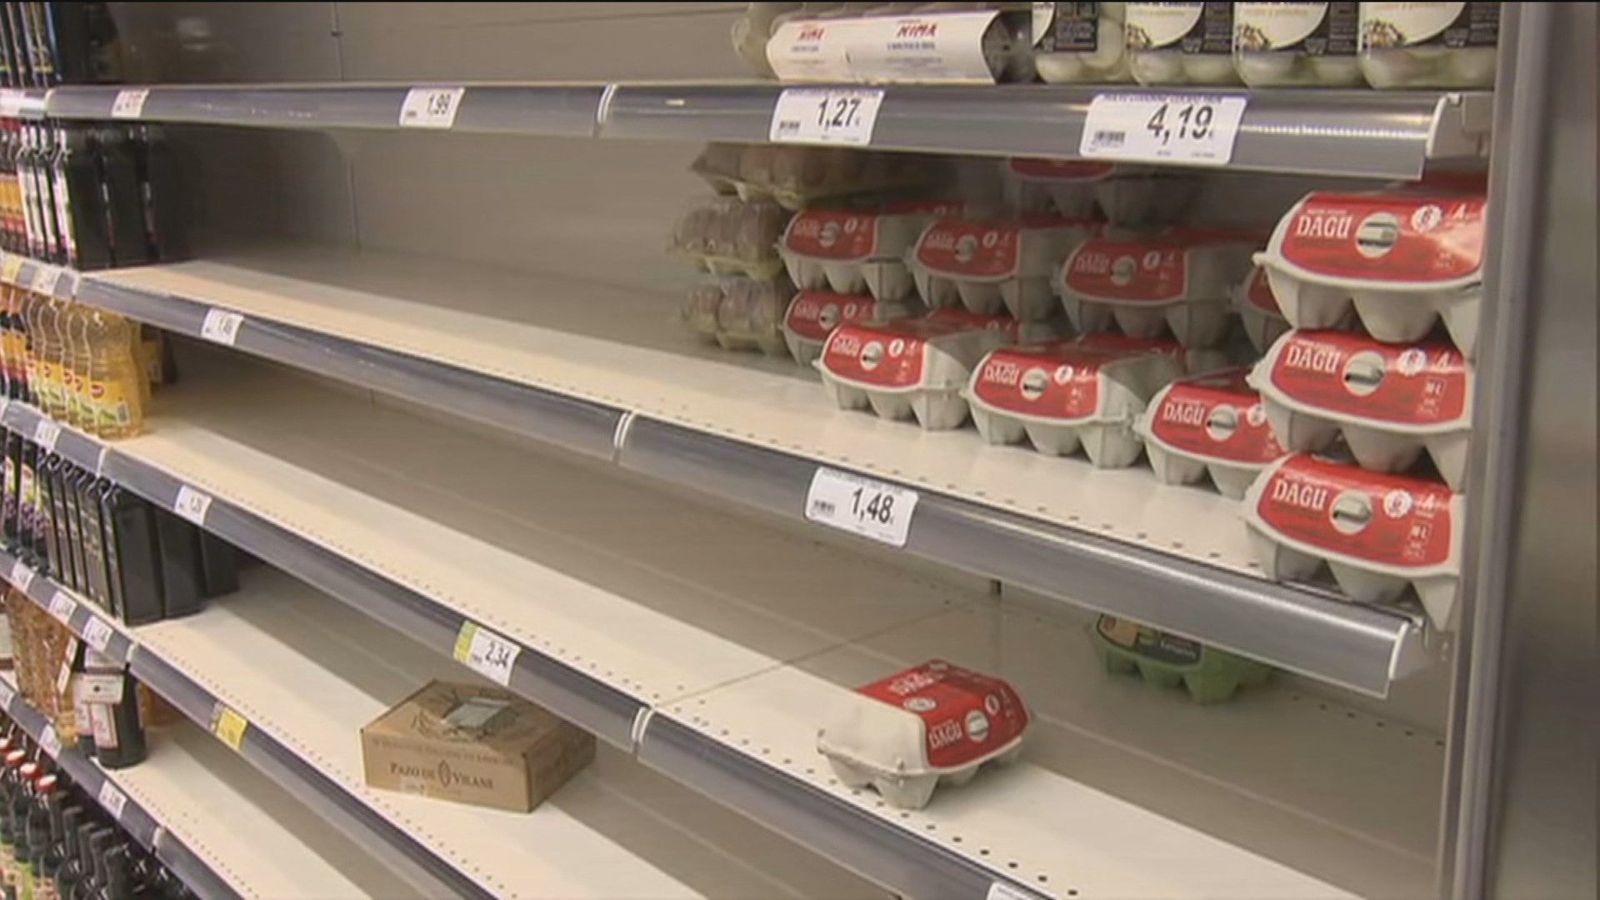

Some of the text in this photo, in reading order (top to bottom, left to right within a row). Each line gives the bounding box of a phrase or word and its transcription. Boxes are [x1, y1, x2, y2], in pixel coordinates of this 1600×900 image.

[818, 97, 861, 131] 1,27
[1147, 103, 1213, 145] 4,19
[1296, 214, 1353, 240] DAGU
[1285, 344, 1343, 375] DAGU
[1162, 401, 1205, 427] DAGU
[852, 487, 895, 524] 1,48
[1272, 478, 1328, 511] DAGU
